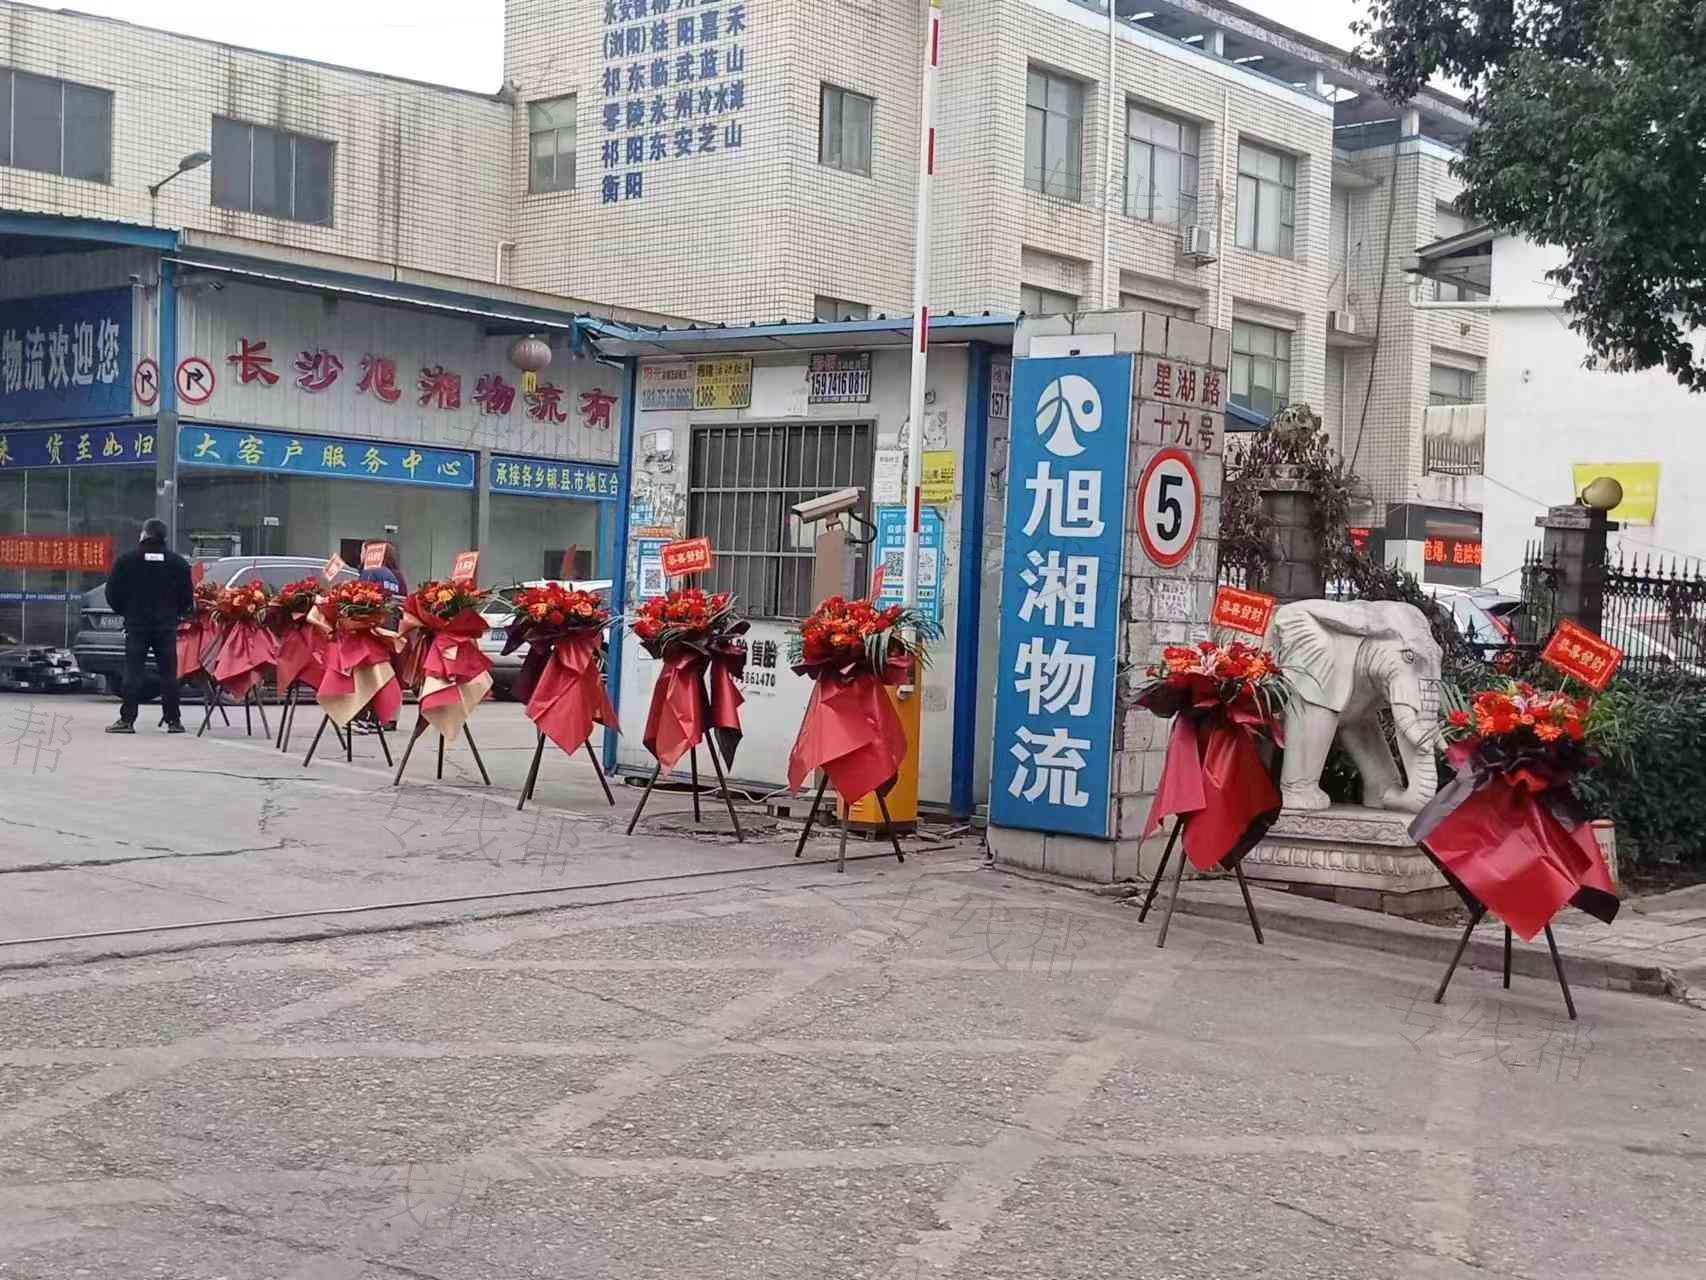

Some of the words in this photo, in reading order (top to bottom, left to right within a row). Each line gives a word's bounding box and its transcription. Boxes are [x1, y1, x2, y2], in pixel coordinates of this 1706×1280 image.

[602, 120, 742, 168] 祁阳东安芝山
[602, 172, 643, 204] 衡阳
[2, 317, 120, 393] 物流欢迎您
[811, 372, 869, 395] 15974160811
[1153, 362, 1221, 407] 星湖路
[46, 431, 155, 465] 货至如归
[1154, 407, 1214, 450] 十九号
[194, 431, 461, 478] 大客户服务中心
[1156, 474, 1184, 541] 5
[1008, 461, 1105, 808] 旭湘物流
